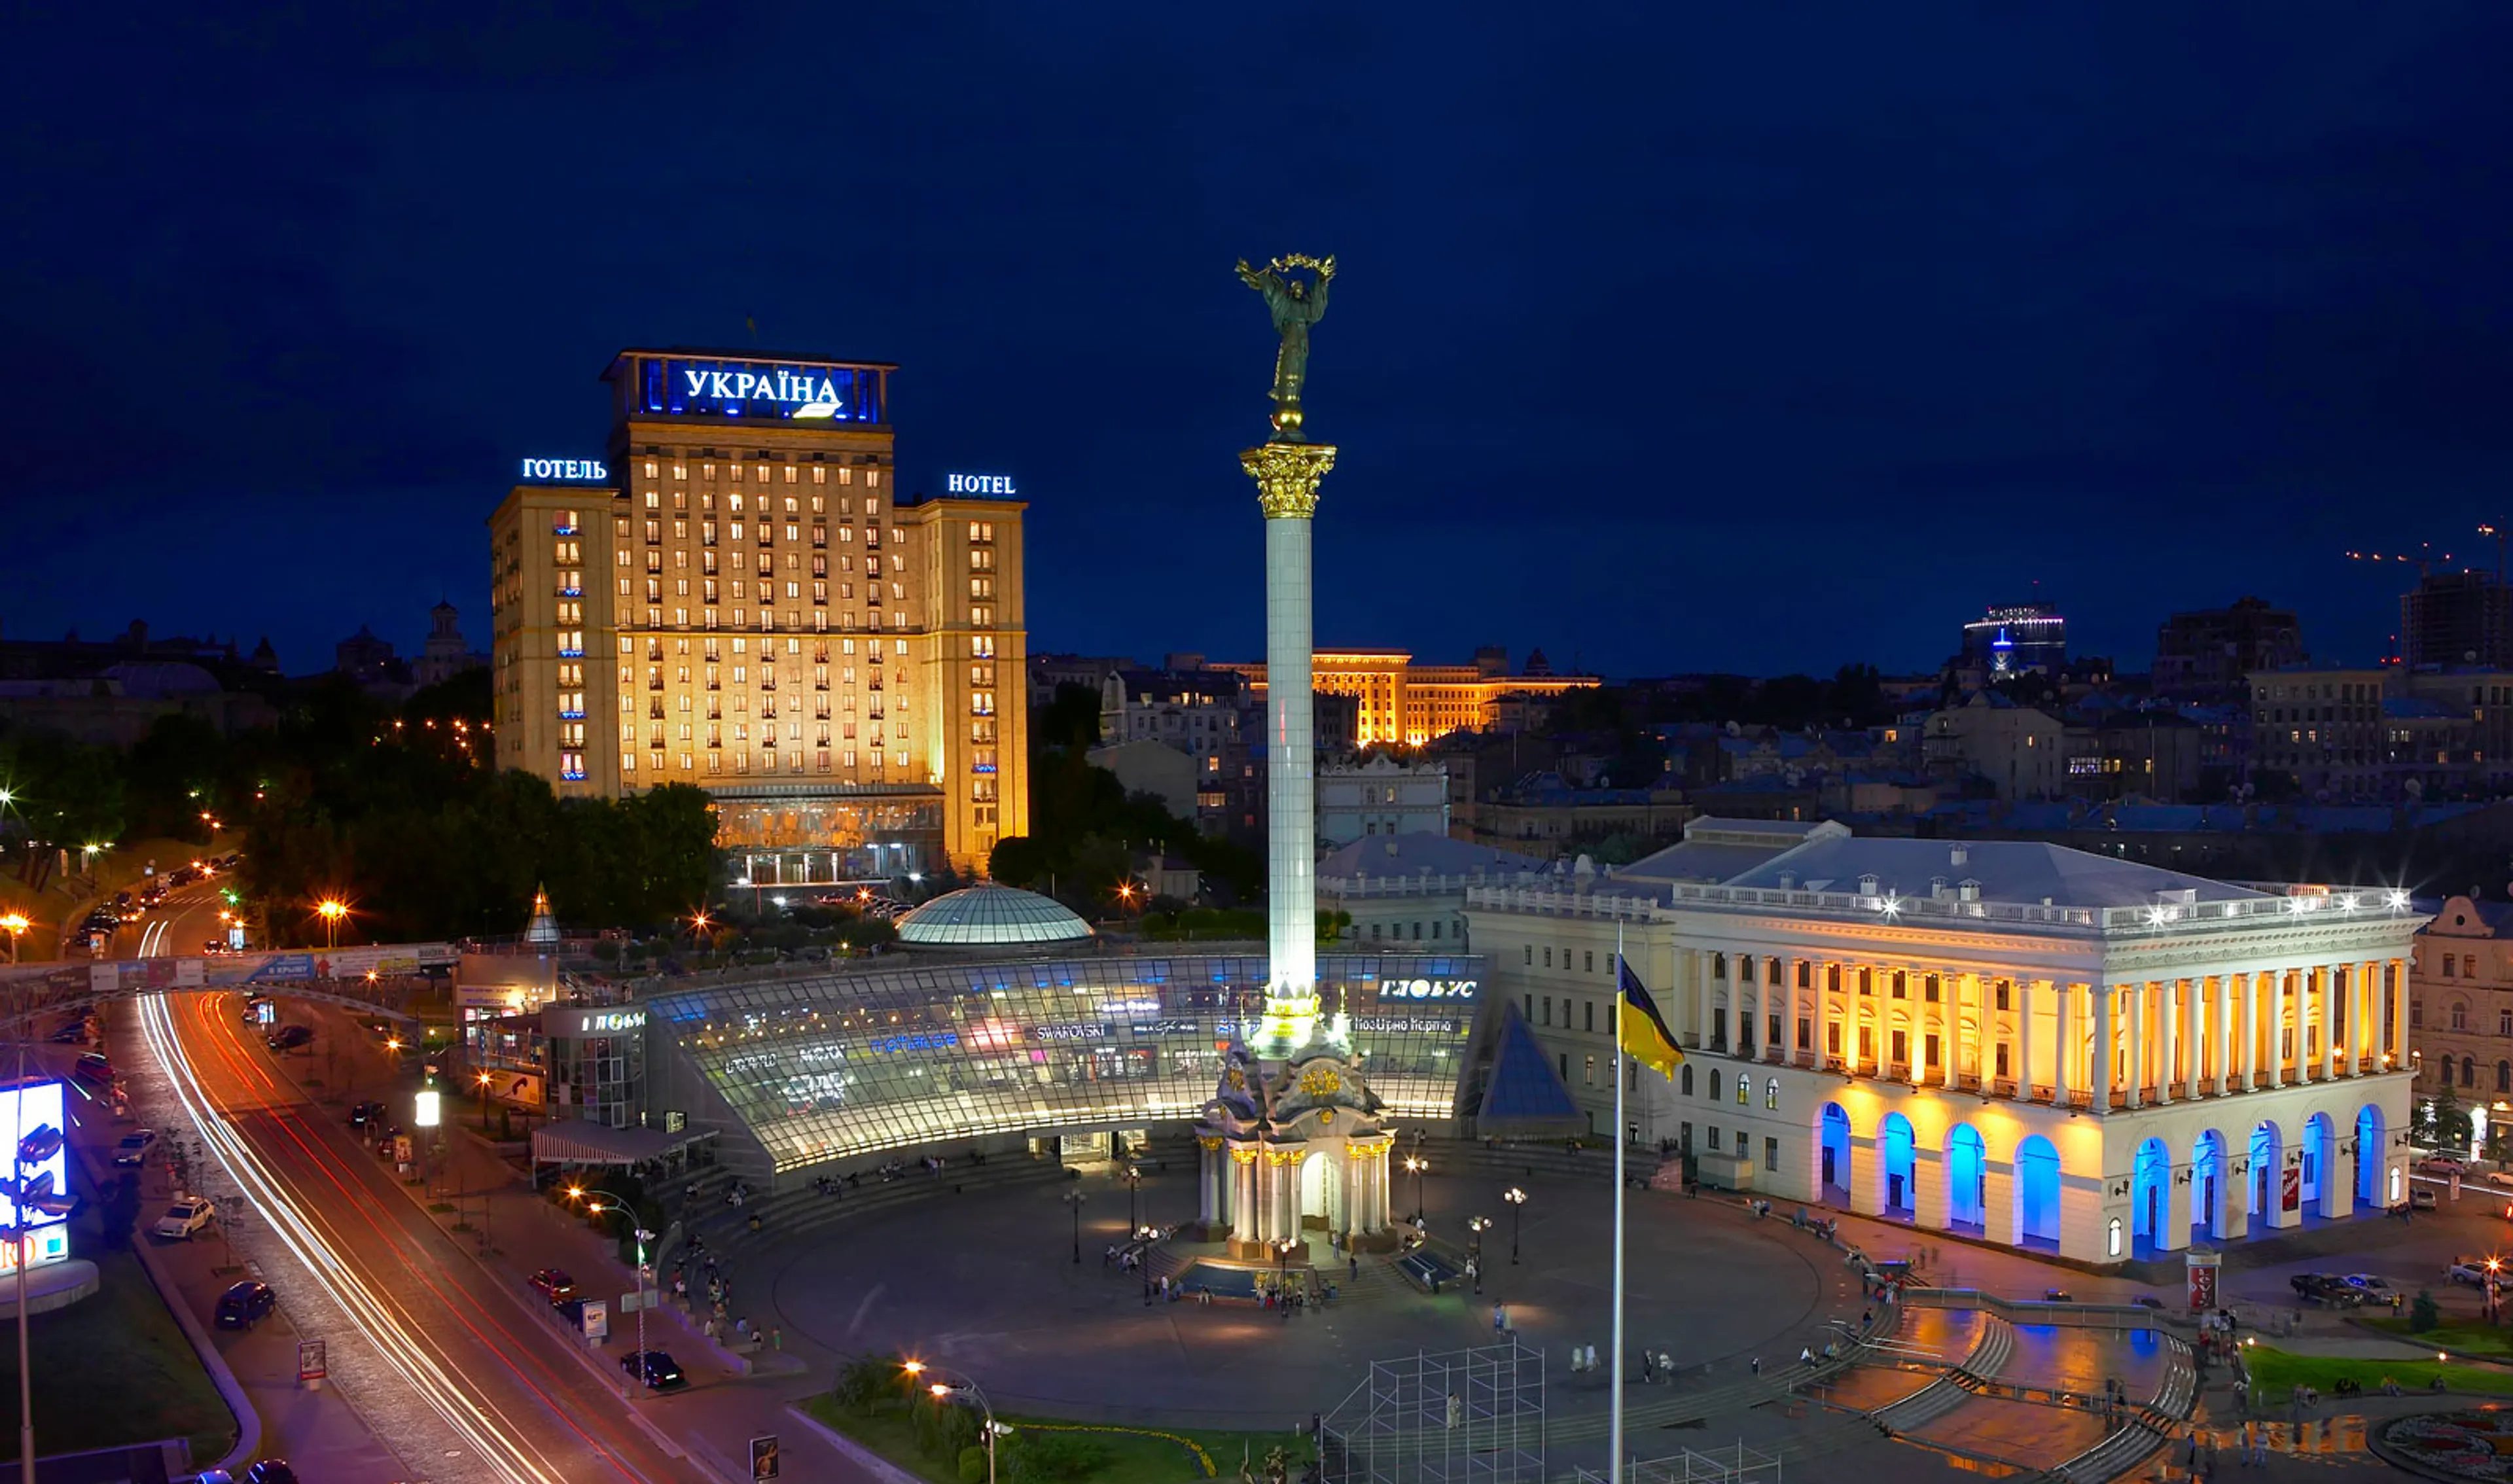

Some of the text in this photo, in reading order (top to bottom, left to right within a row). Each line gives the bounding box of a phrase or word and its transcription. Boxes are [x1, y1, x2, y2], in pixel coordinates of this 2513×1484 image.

[685, 370, 839, 404] УКРАЇНА
[523, 458, 607, 479] ГОТЕЛЬ
[948, 474, 1017, 494] HOTEL
[1379, 980, 1478, 998] ГЛОБУС
[1037, 1023, 1105, 1040] SWAROVSKI
